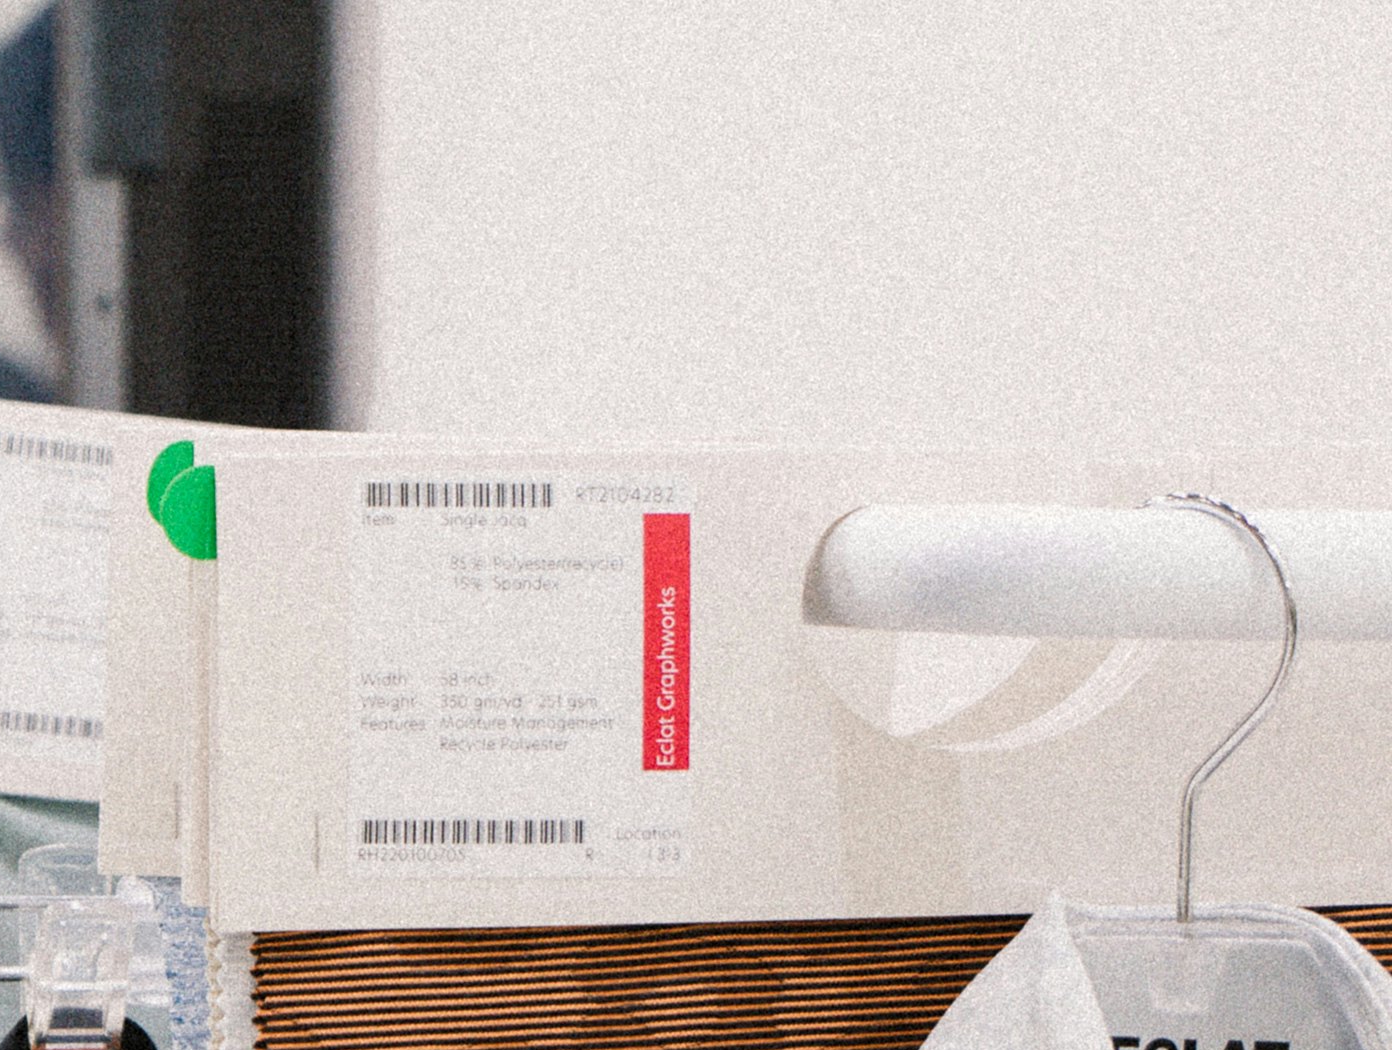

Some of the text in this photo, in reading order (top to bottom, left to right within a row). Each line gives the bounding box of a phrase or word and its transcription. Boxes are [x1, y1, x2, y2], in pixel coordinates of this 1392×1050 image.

[492, 574, 559, 593] Spandex
[656, 585, 679, 767] Eclat Graphworks
[511, 715, 615, 734] Management
